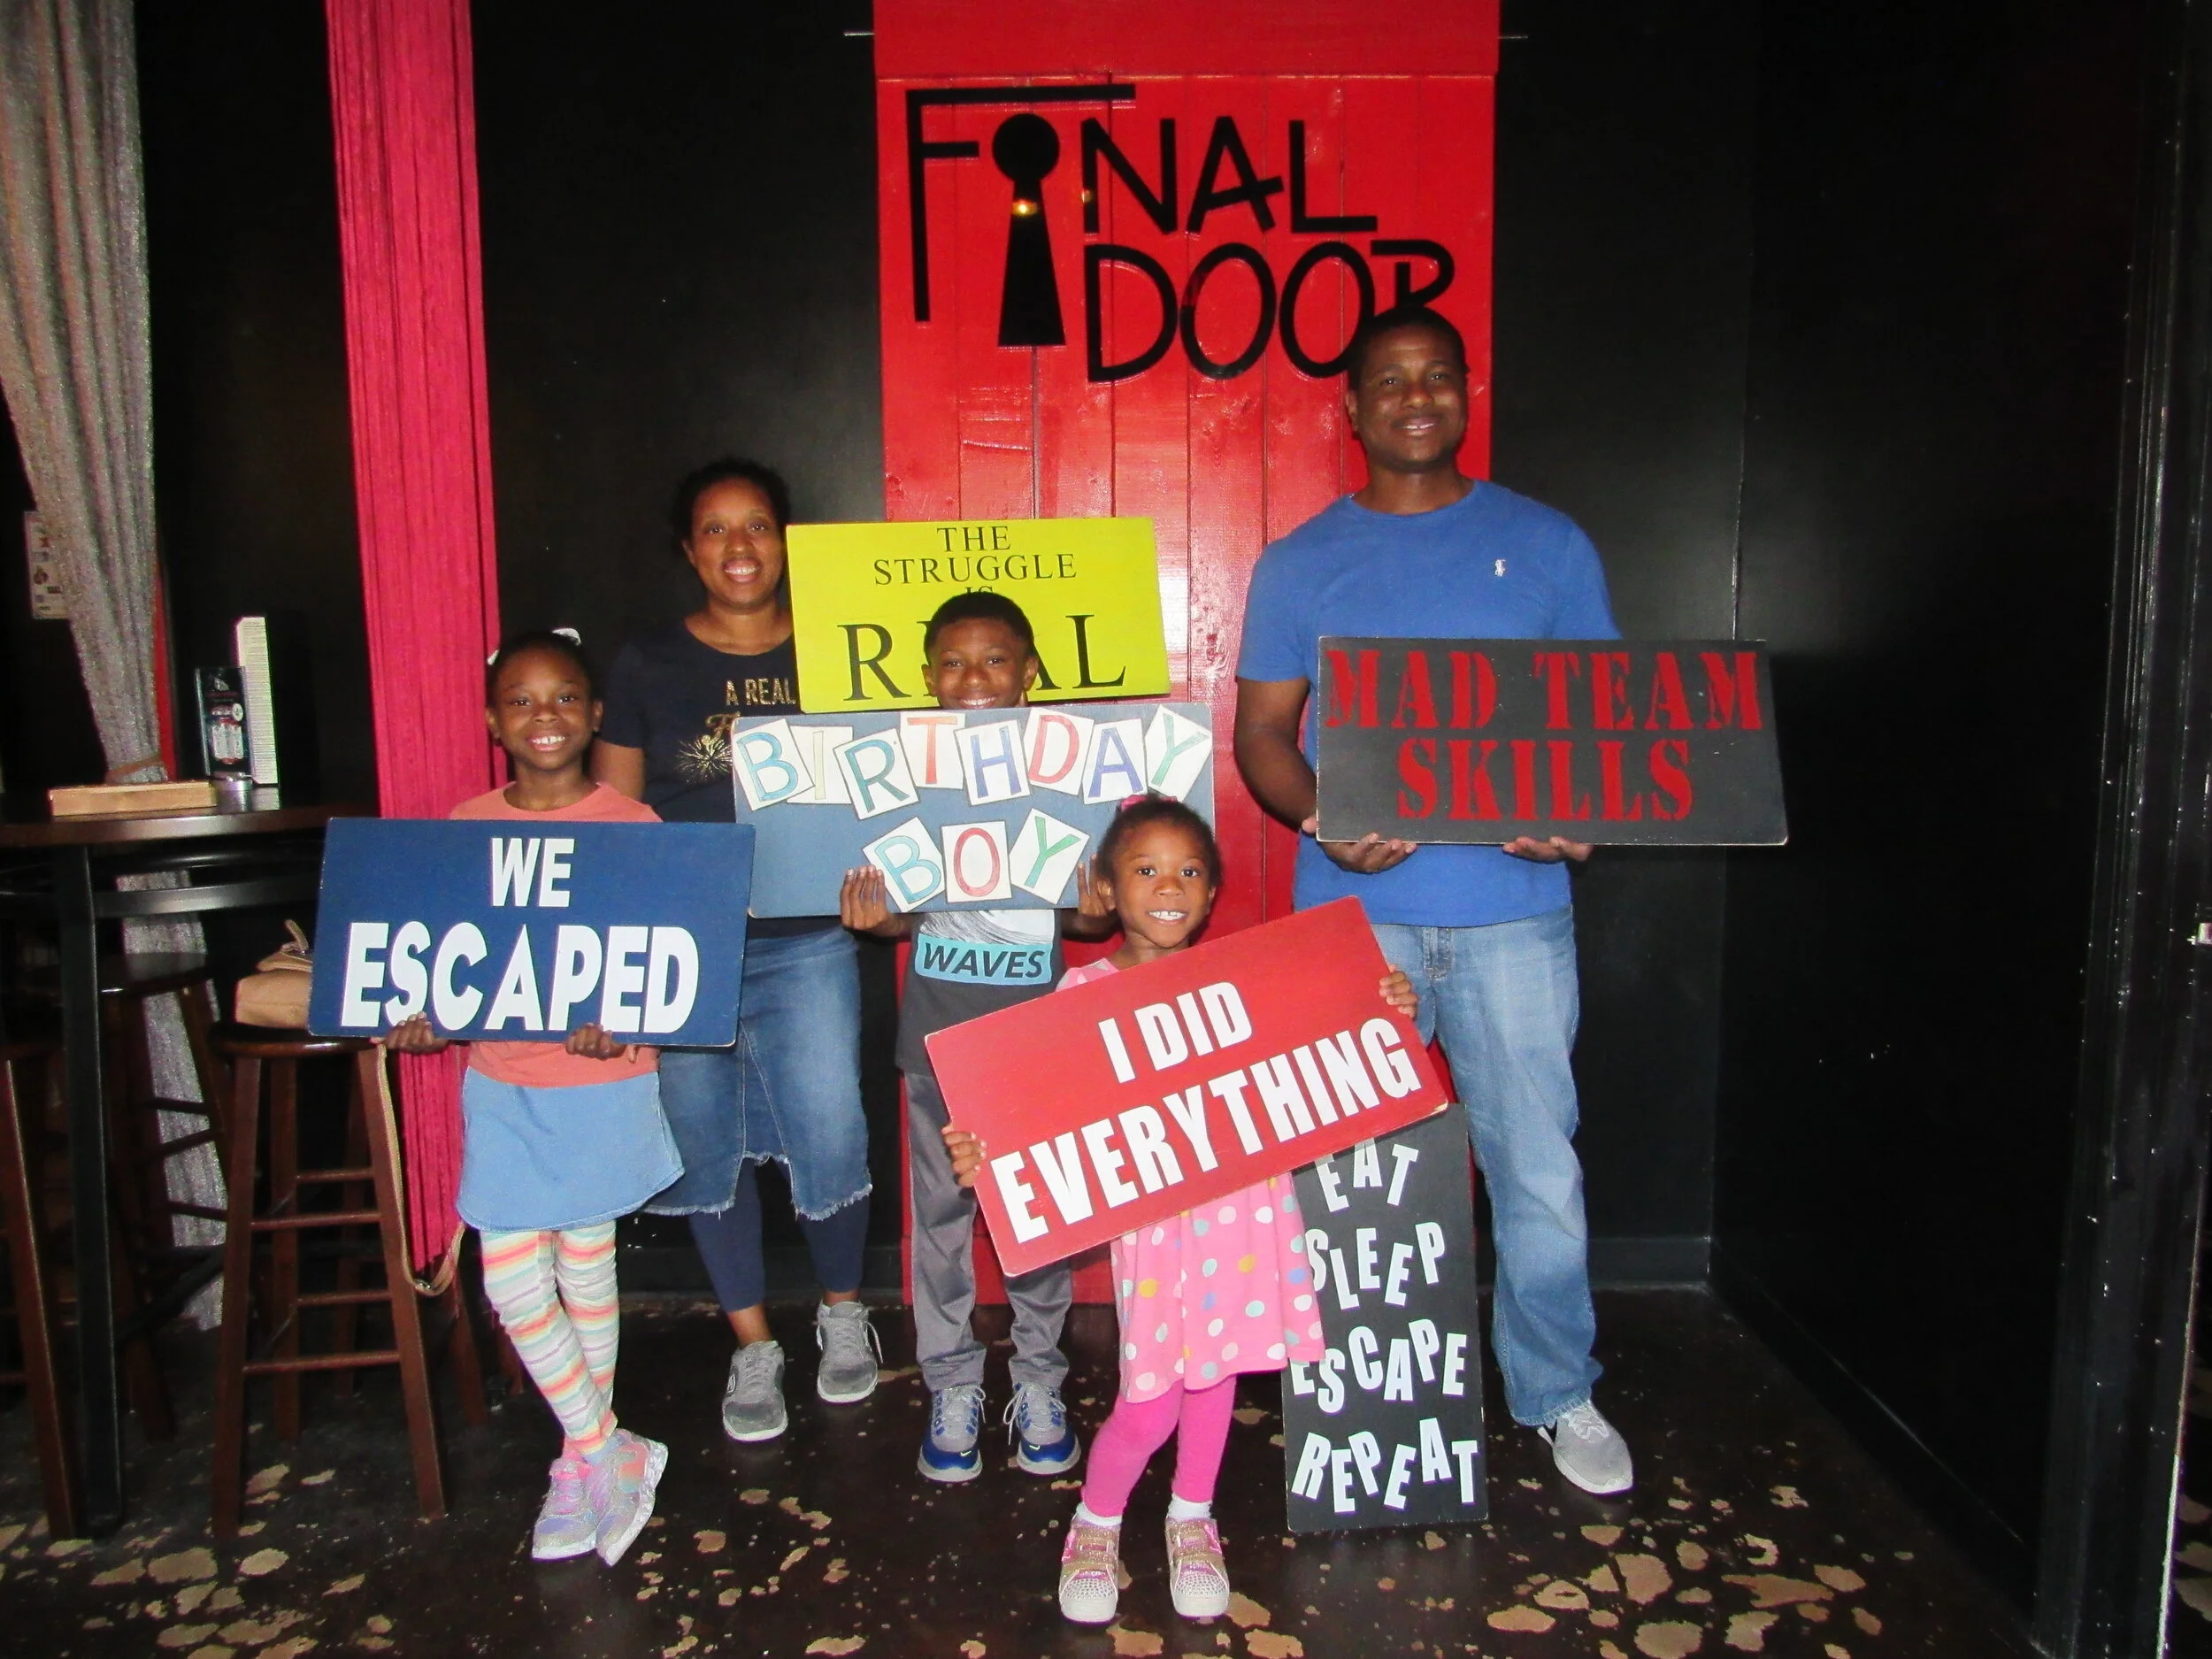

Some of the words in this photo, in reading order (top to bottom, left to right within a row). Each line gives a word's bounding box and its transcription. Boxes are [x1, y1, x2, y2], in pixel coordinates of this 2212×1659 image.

[906, 83, 1379, 348] FINAL
[873, 553, 1078, 586] STRUGGLE
[936, 526, 1011, 552] THE
[726, 678, 740, 706] A
[744, 677, 796, 705] REAL
[837, 612, 1127, 702] RL
[1326, 649, 1499, 729] MAD
[1532, 651, 1763, 730] TEAM
[736, 712, 1210, 815] BIRTHDAY
[1396, 737, 1694, 822] SKILLS
[491, 837, 575, 908] WE
[881, 814, 1081, 905] BOY
[341, 920, 699, 1033] ESCAPED
[923, 942, 1046, 979] WAVES
[1098, 1018, 1136, 1084] I
[1133, 981, 1252, 1071] DID
[990, 1018, 1422, 1244] EVERYTHING
[1316, 1138, 1419, 1213] EAT
[1305, 1221, 1447, 1310] SLEEP
[1289, 1317, 1467, 1414] ESCAPE
[1291, 1417, 1479, 1513] REPEAT
